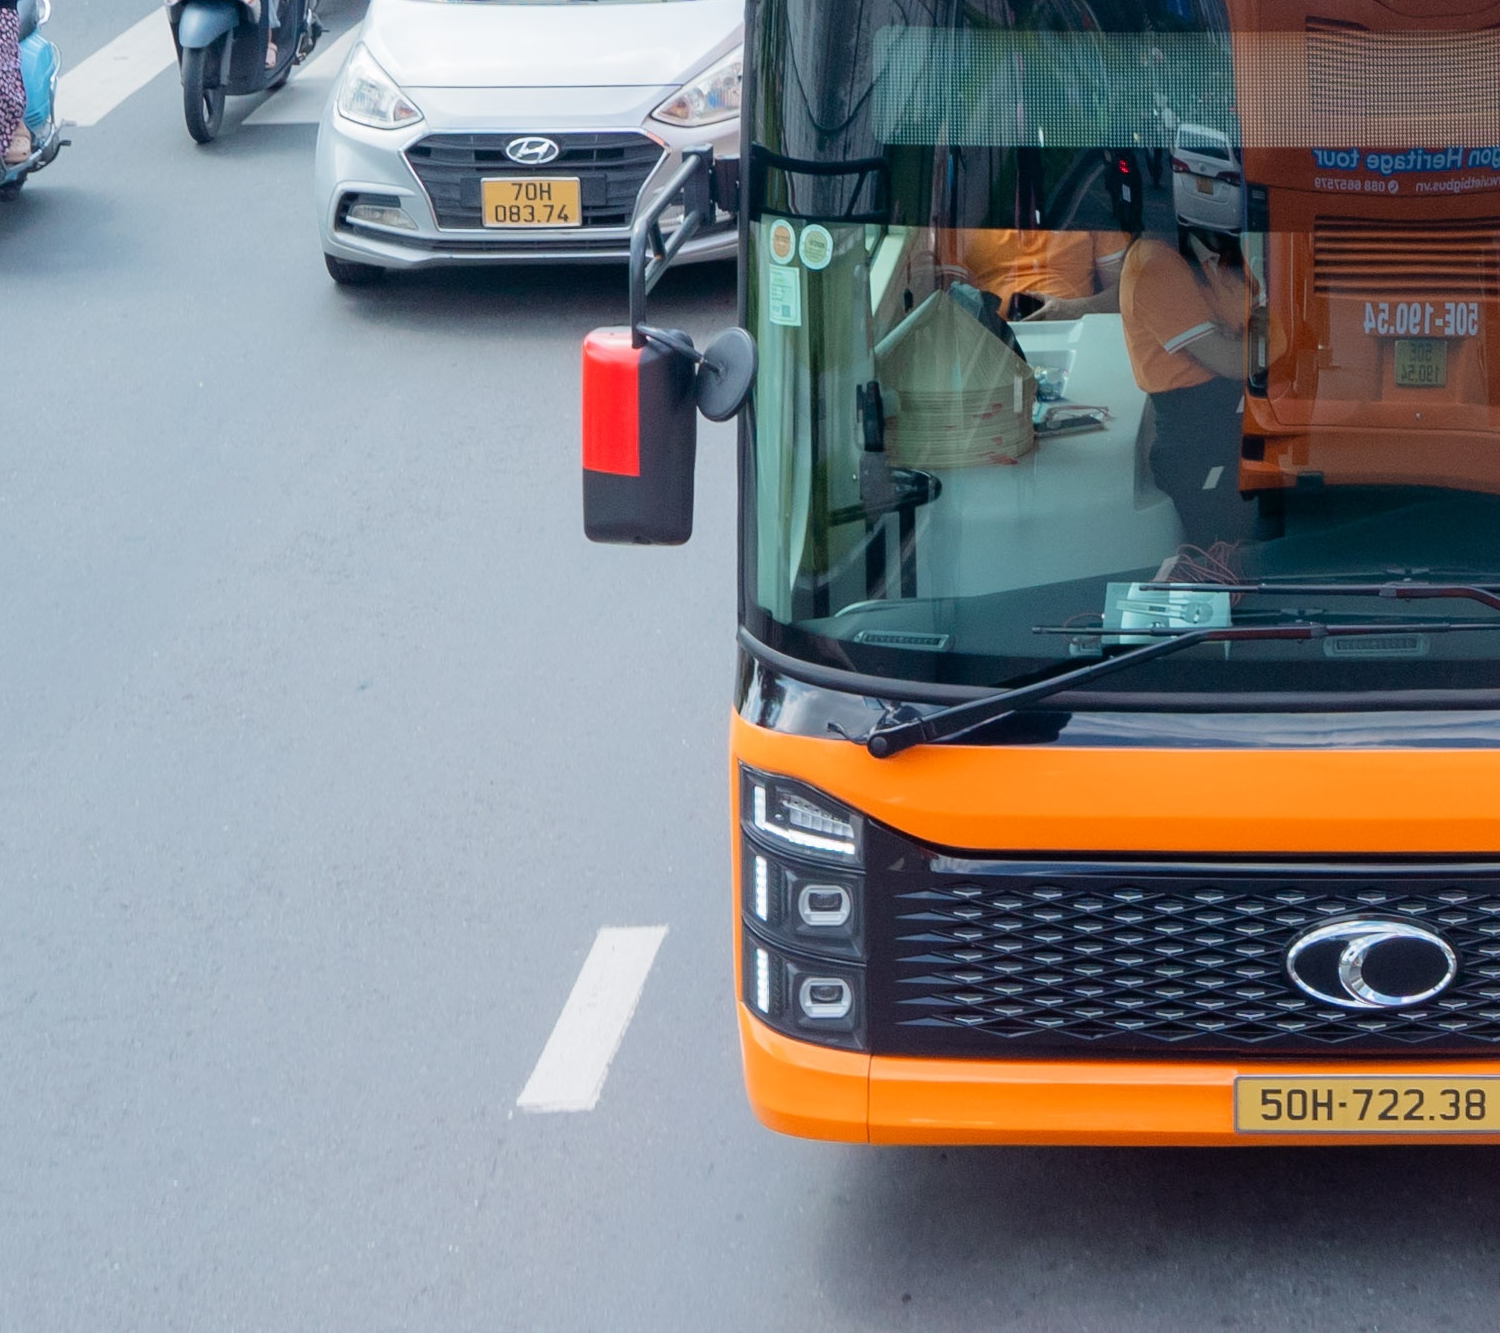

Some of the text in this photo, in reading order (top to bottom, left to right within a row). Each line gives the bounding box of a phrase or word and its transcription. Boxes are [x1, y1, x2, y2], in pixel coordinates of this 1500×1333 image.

[511, 182, 552, 201] 70H
[495, 204, 569, 223] 083.74
[1261, 1088, 1486, 1121] 50H-722.38
